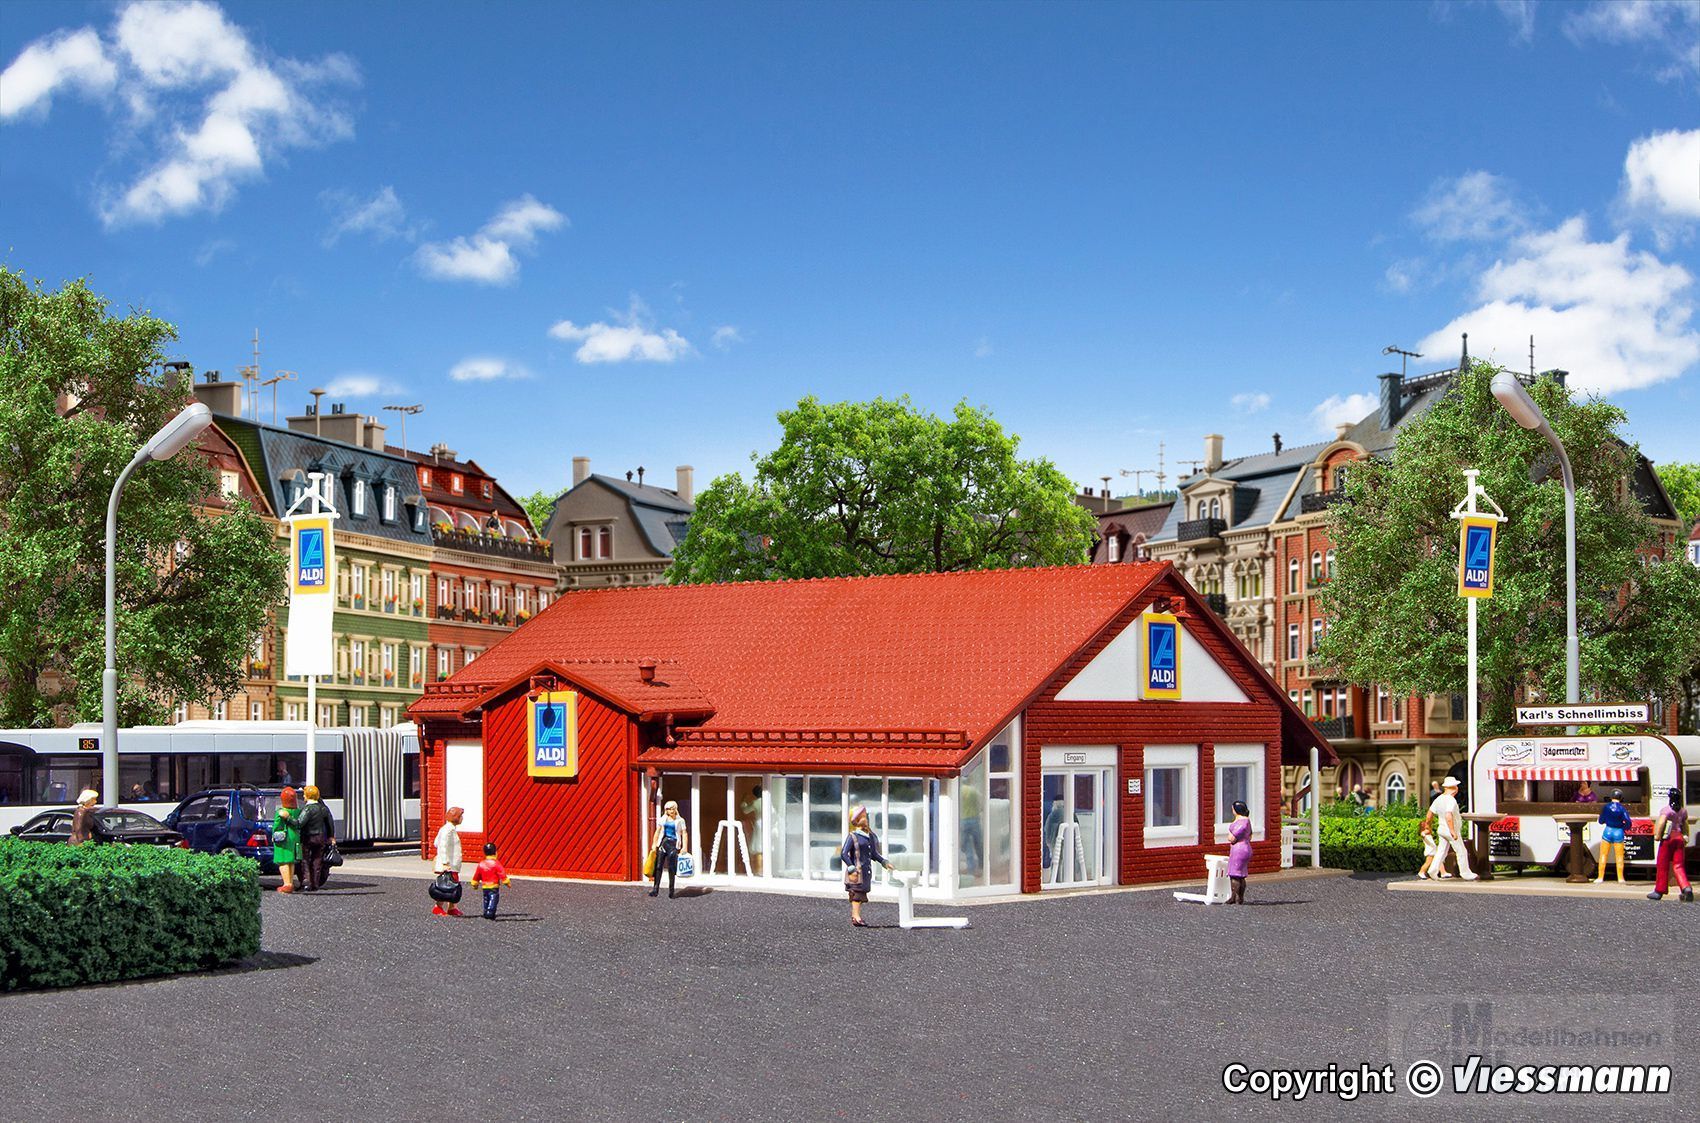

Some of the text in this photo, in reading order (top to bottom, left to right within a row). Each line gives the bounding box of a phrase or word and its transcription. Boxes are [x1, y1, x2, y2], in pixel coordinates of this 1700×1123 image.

[300, 568, 324, 581] ALDI
[1465, 569, 1488, 583] ALDI
[1151, 669, 1174, 682] ALDI
[1520, 709, 1644, 720] Karl's Schnellimbiss
[82, 739, 95, 750] 85
[537, 748, 564, 760] ALDI
[679, 860, 692, 871] O.K.
